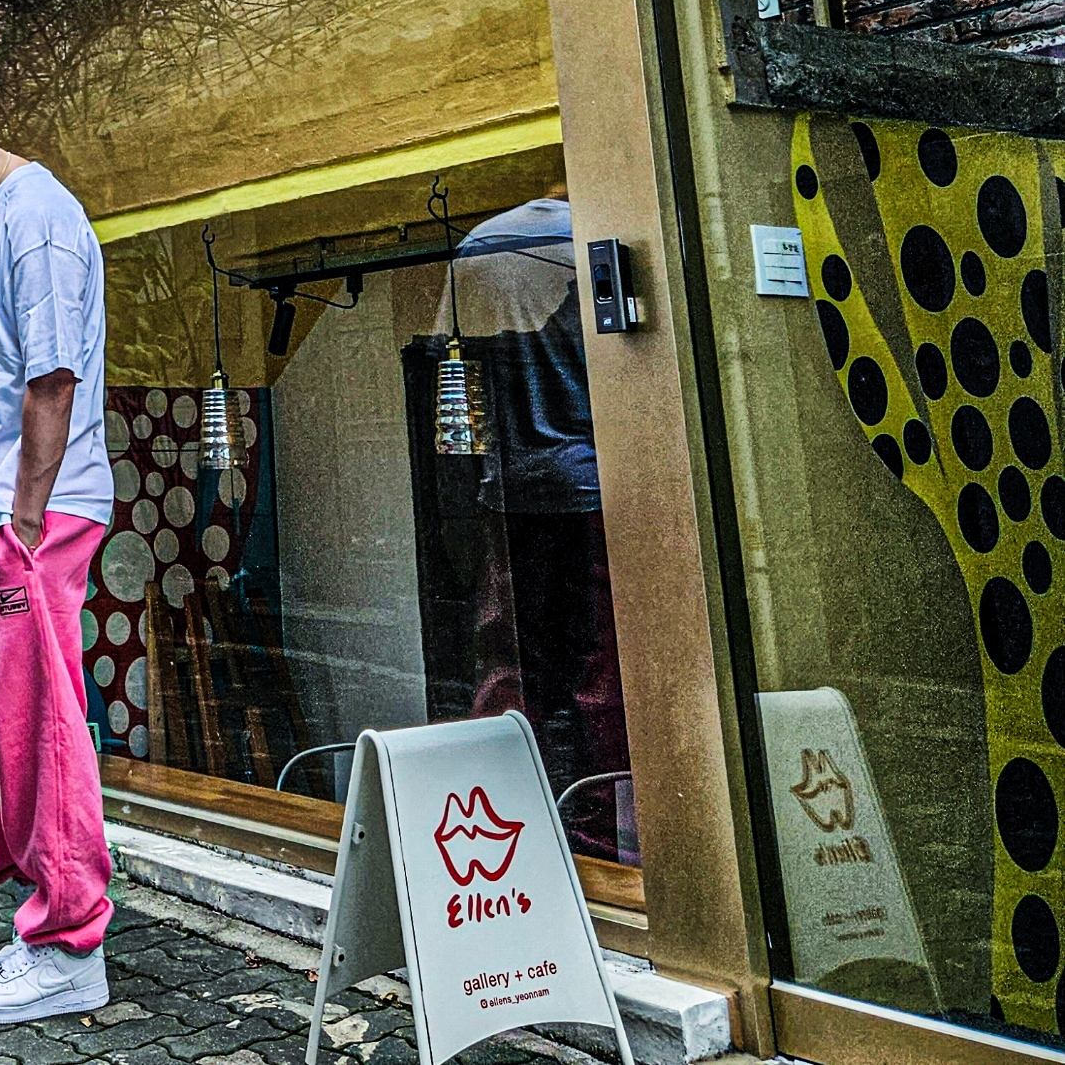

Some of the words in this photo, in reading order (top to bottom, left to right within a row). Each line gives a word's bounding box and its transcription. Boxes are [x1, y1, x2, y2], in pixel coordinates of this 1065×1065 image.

[446, 887, 532, 928] Ellen's
[463, 972, 510, 996] gallery
[514, 969, 523, 982] +
[527, 959, 558, 980] cafe
